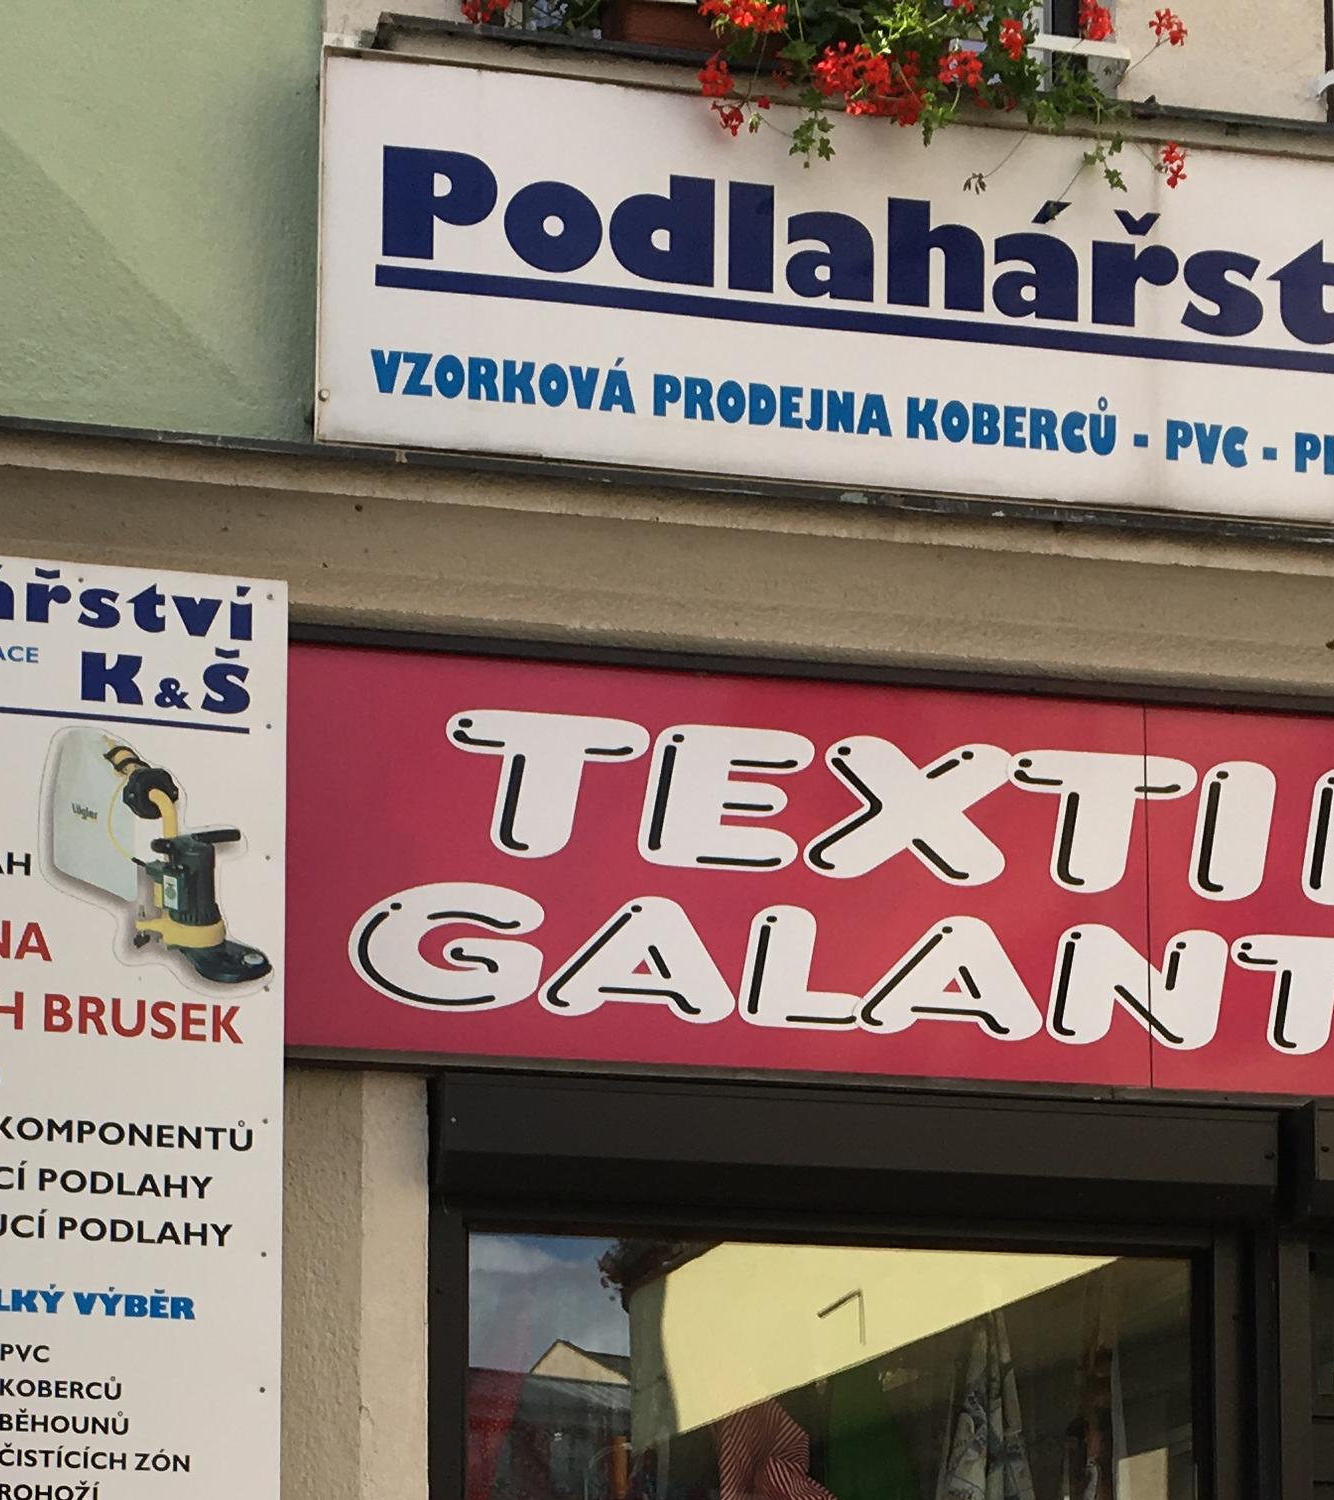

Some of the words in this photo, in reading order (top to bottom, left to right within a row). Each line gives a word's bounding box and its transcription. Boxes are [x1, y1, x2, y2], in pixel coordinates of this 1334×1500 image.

[370, 347, 636, 415] VZORKOVÁ
[652, 373, 893, 438] PRODEJNA
[906, 394, 1117, 457] KOBERCŮ
[1166, 418, 1248, 470] PVC
[79, 646, 252, 716] K&Š
[43, 997, 244, 1045] BRUSEK
[38, 1168, 213, 1201] PODLAHY
[57, 1216, 233, 1248] PODLAHY
[73, 1286, 197, 1321] VÝBĚR
[0, 1343, 51, 1364] PVC
[134, 1448, 191, 1473] ZÓN
